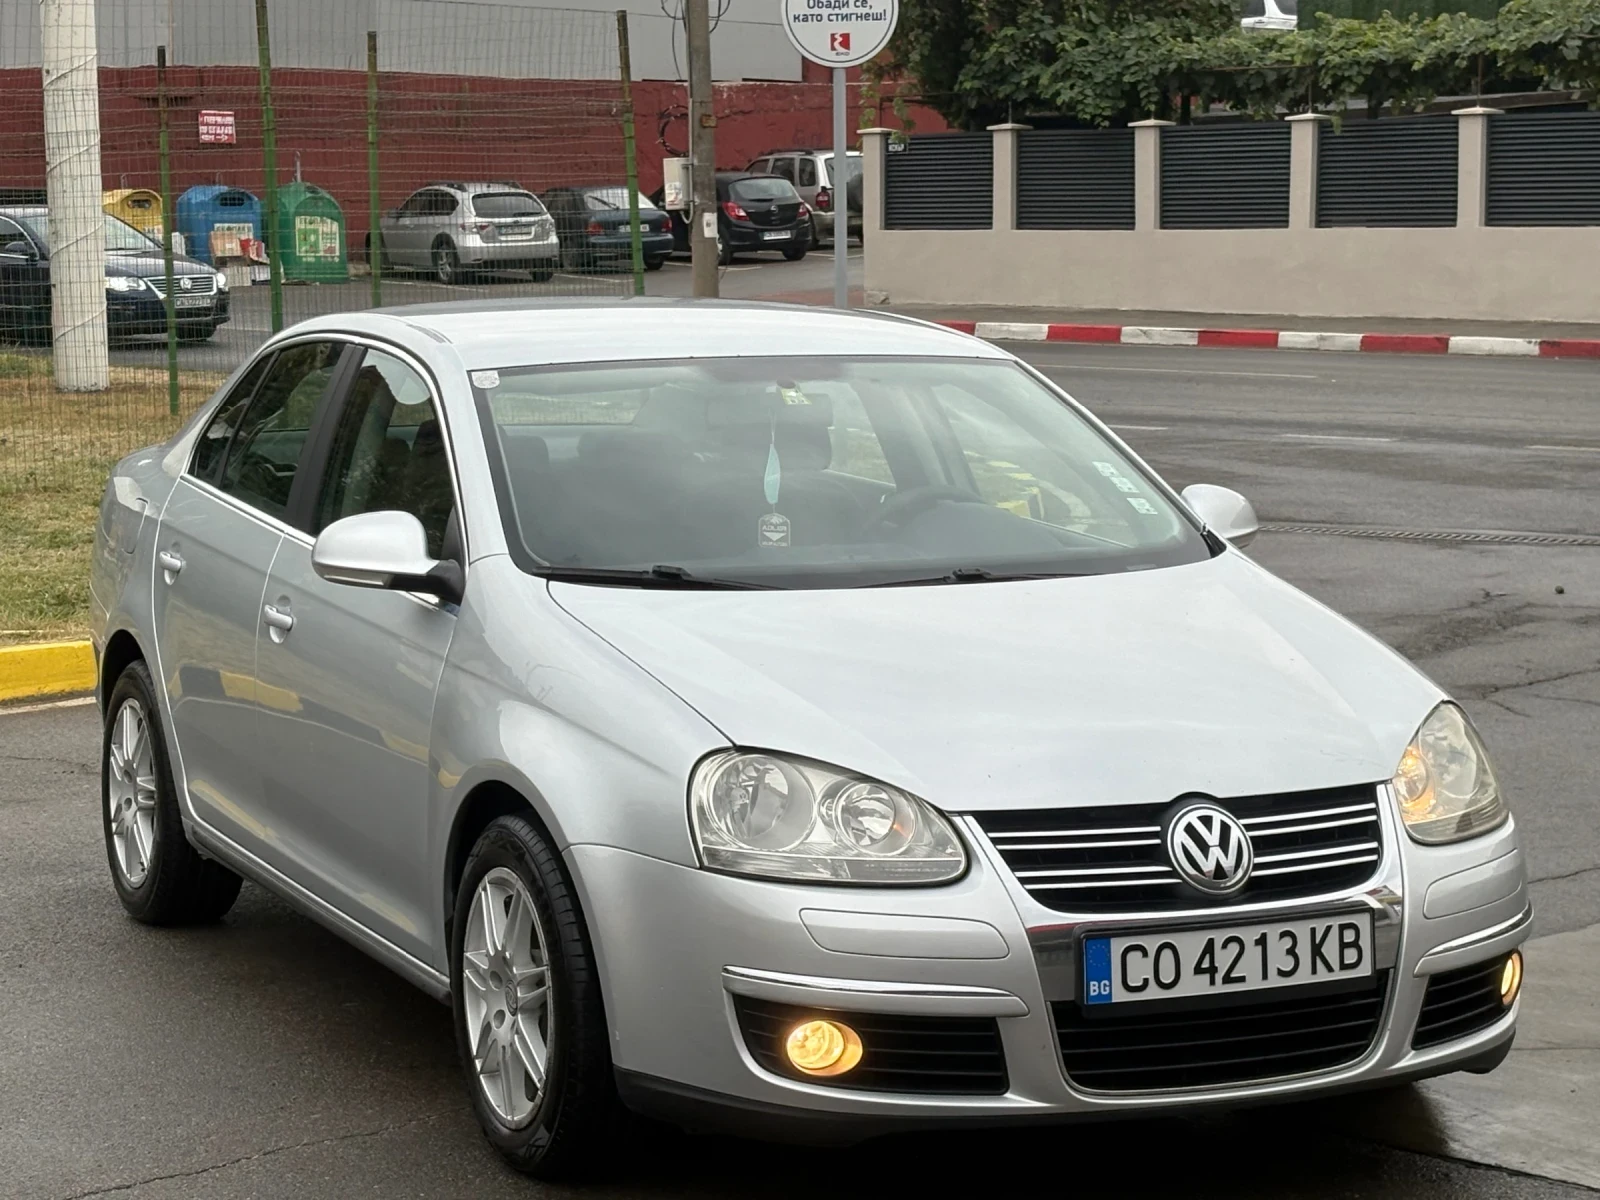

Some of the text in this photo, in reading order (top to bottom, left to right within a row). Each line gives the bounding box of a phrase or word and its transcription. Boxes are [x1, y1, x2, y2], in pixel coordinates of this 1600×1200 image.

[807, 0, 873, 10] Обади се,
[793, 9, 887, 23] като стигнеш!
[1120, 922, 1363, 993] CO 4213 KB
[1089, 980, 1110, 996] BG
